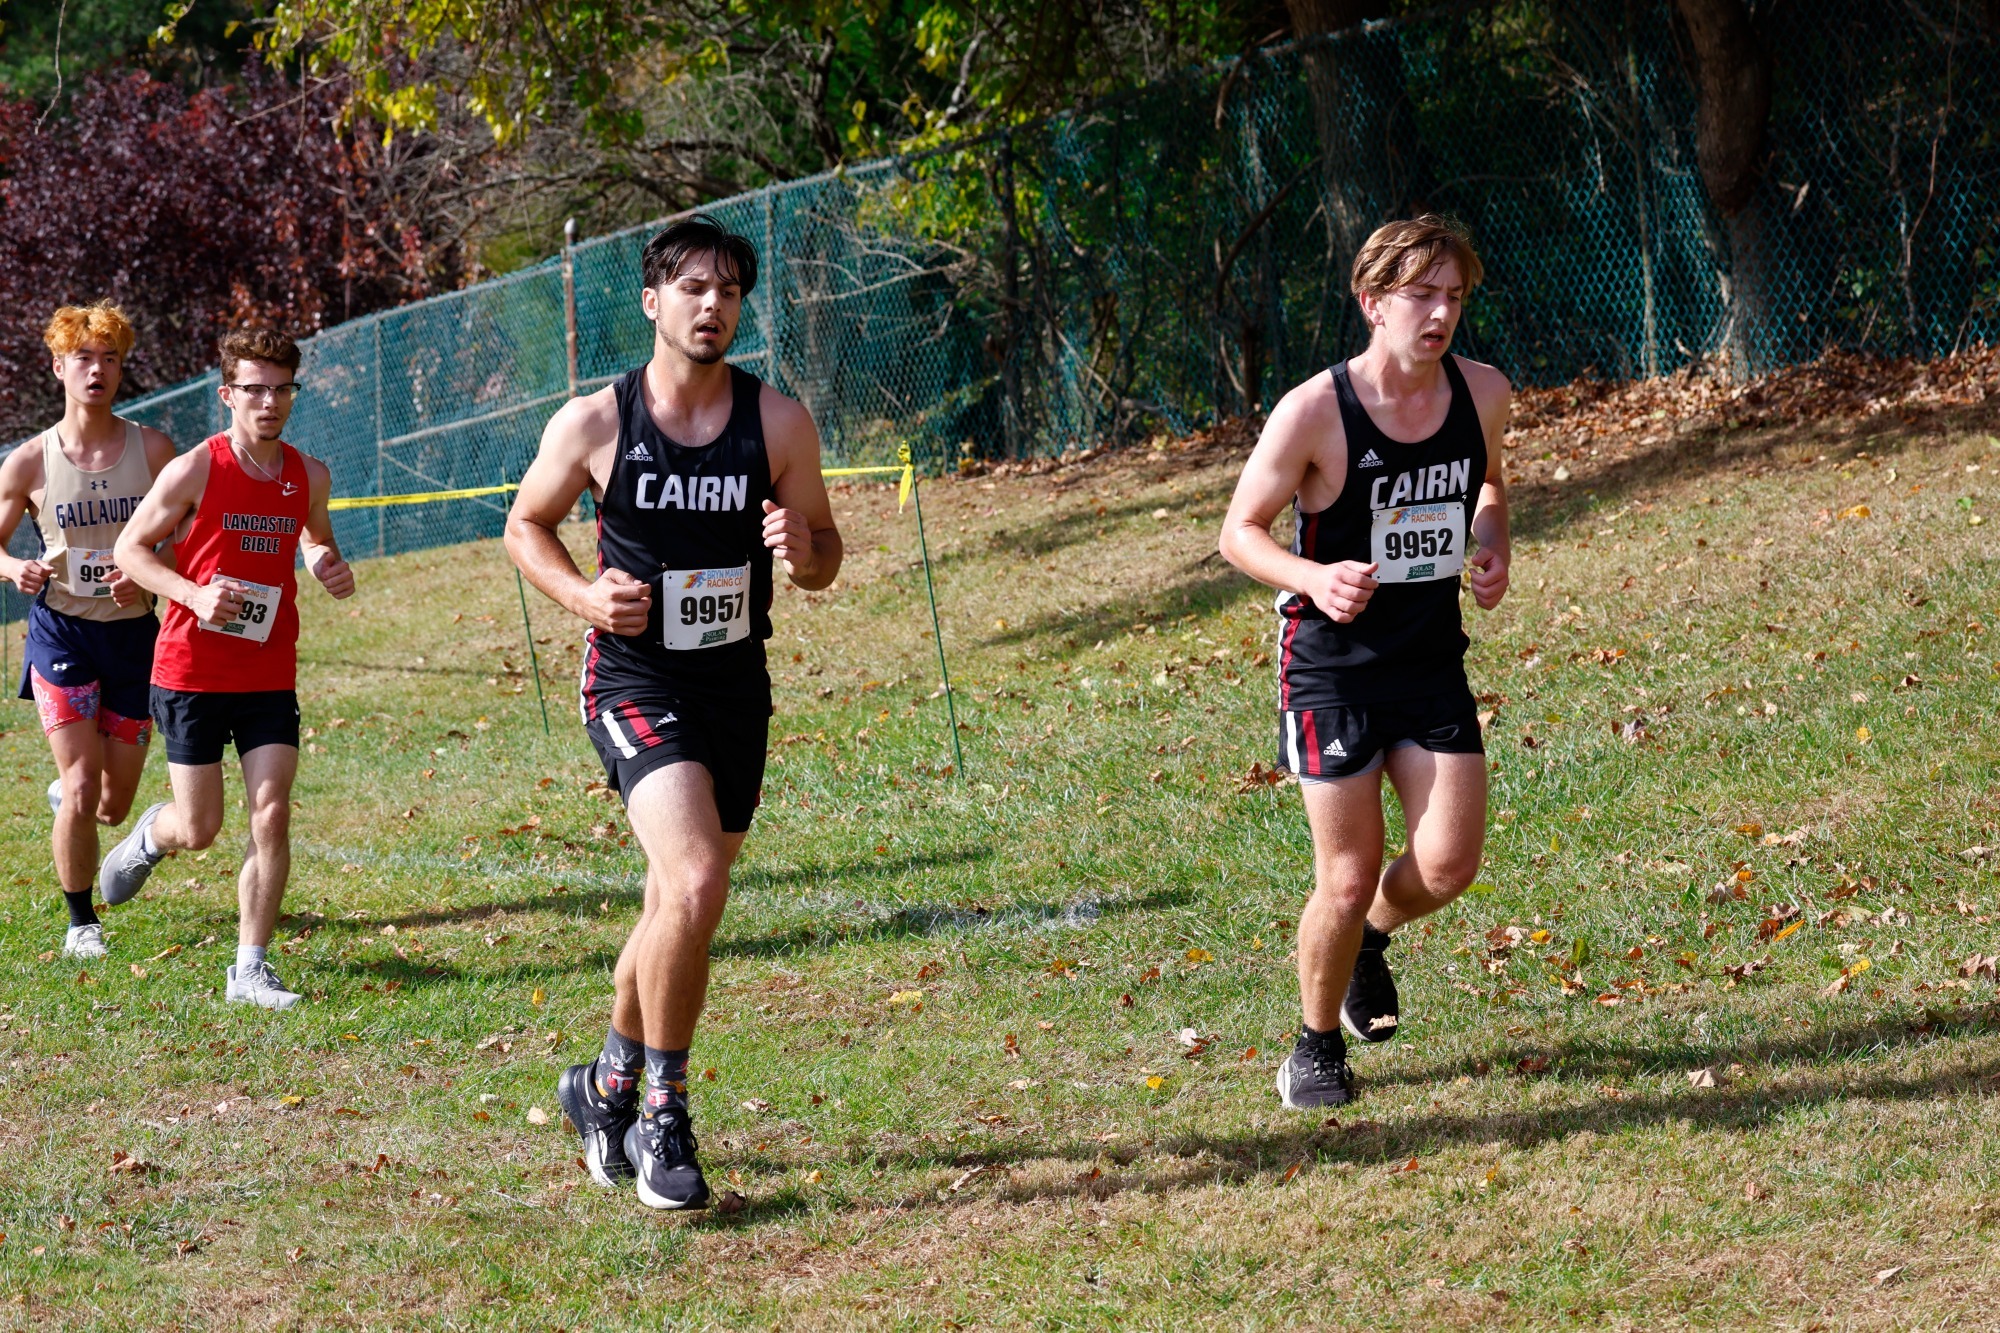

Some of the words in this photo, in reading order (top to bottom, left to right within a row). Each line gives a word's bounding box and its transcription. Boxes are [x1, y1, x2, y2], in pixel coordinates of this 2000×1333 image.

[625, 453, 653, 462] adidas
[1358, 460, 1384, 468] adidas
[635, 472, 748, 512] CAIRN
[1369, 457, 1471, 511] CAIRN
[55, 496, 145, 529] GALLAUDE
[1411, 505, 1427, 515] BRYN
[1427, 503, 1447, 513] MAWR
[1411, 513, 1436, 523] RACING
[1437, 512, 1447, 521] CO
[223, 513, 297, 534] LANCASTER
[240, 535, 280, 554] BIBLE
[1385, 527, 1453, 561] 9952
[706, 569, 724, 580] BRYN
[725, 567, 744, 578] MAWR
[707, 578, 733, 588] RACING
[239, 600, 268, 624] 93
[680, 591, 744, 626] 9957
[1323, 749, 1347, 757] adidas
